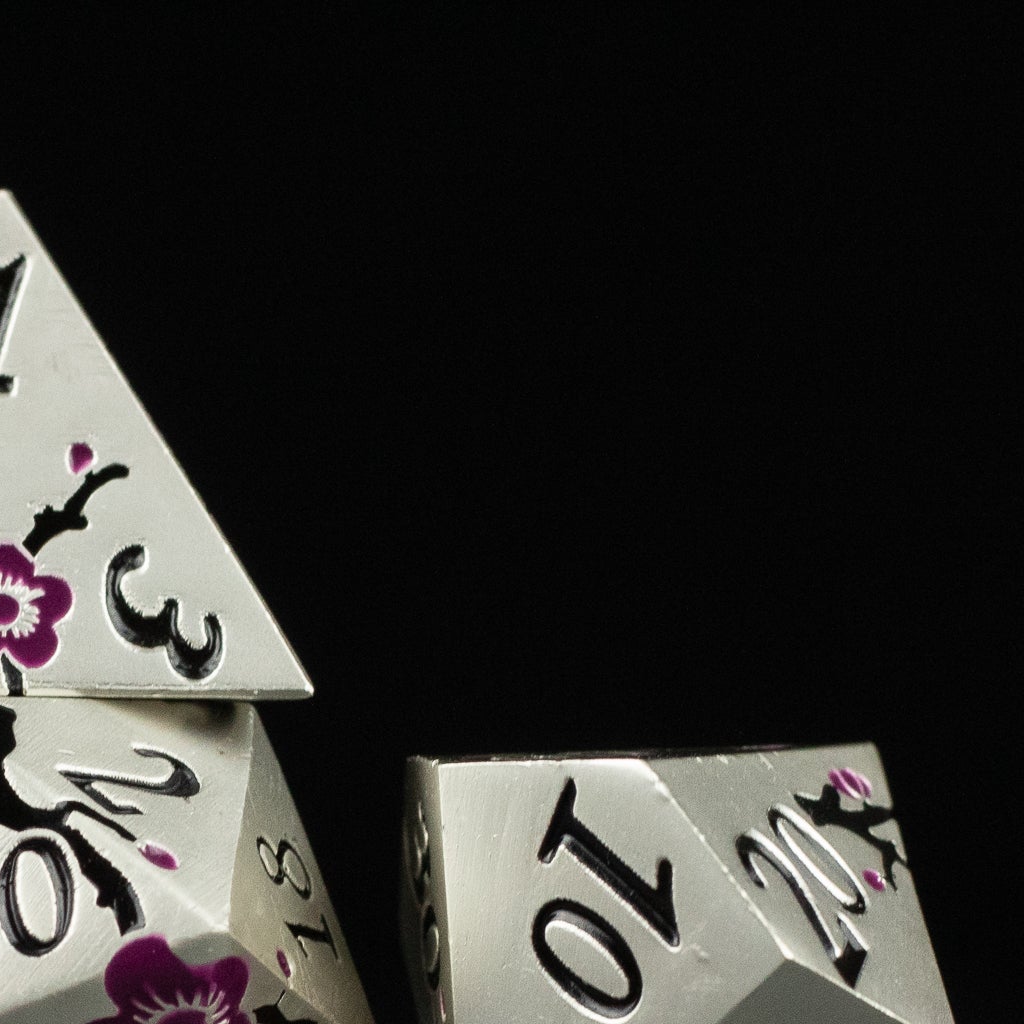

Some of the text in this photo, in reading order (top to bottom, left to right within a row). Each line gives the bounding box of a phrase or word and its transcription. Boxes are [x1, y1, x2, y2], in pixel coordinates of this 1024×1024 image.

[104, 542, 228, 684] 3
[56, 741, 202, 818] 2
[256, 836, 339, 960] 18
[734, 803, 870, 990] 20
